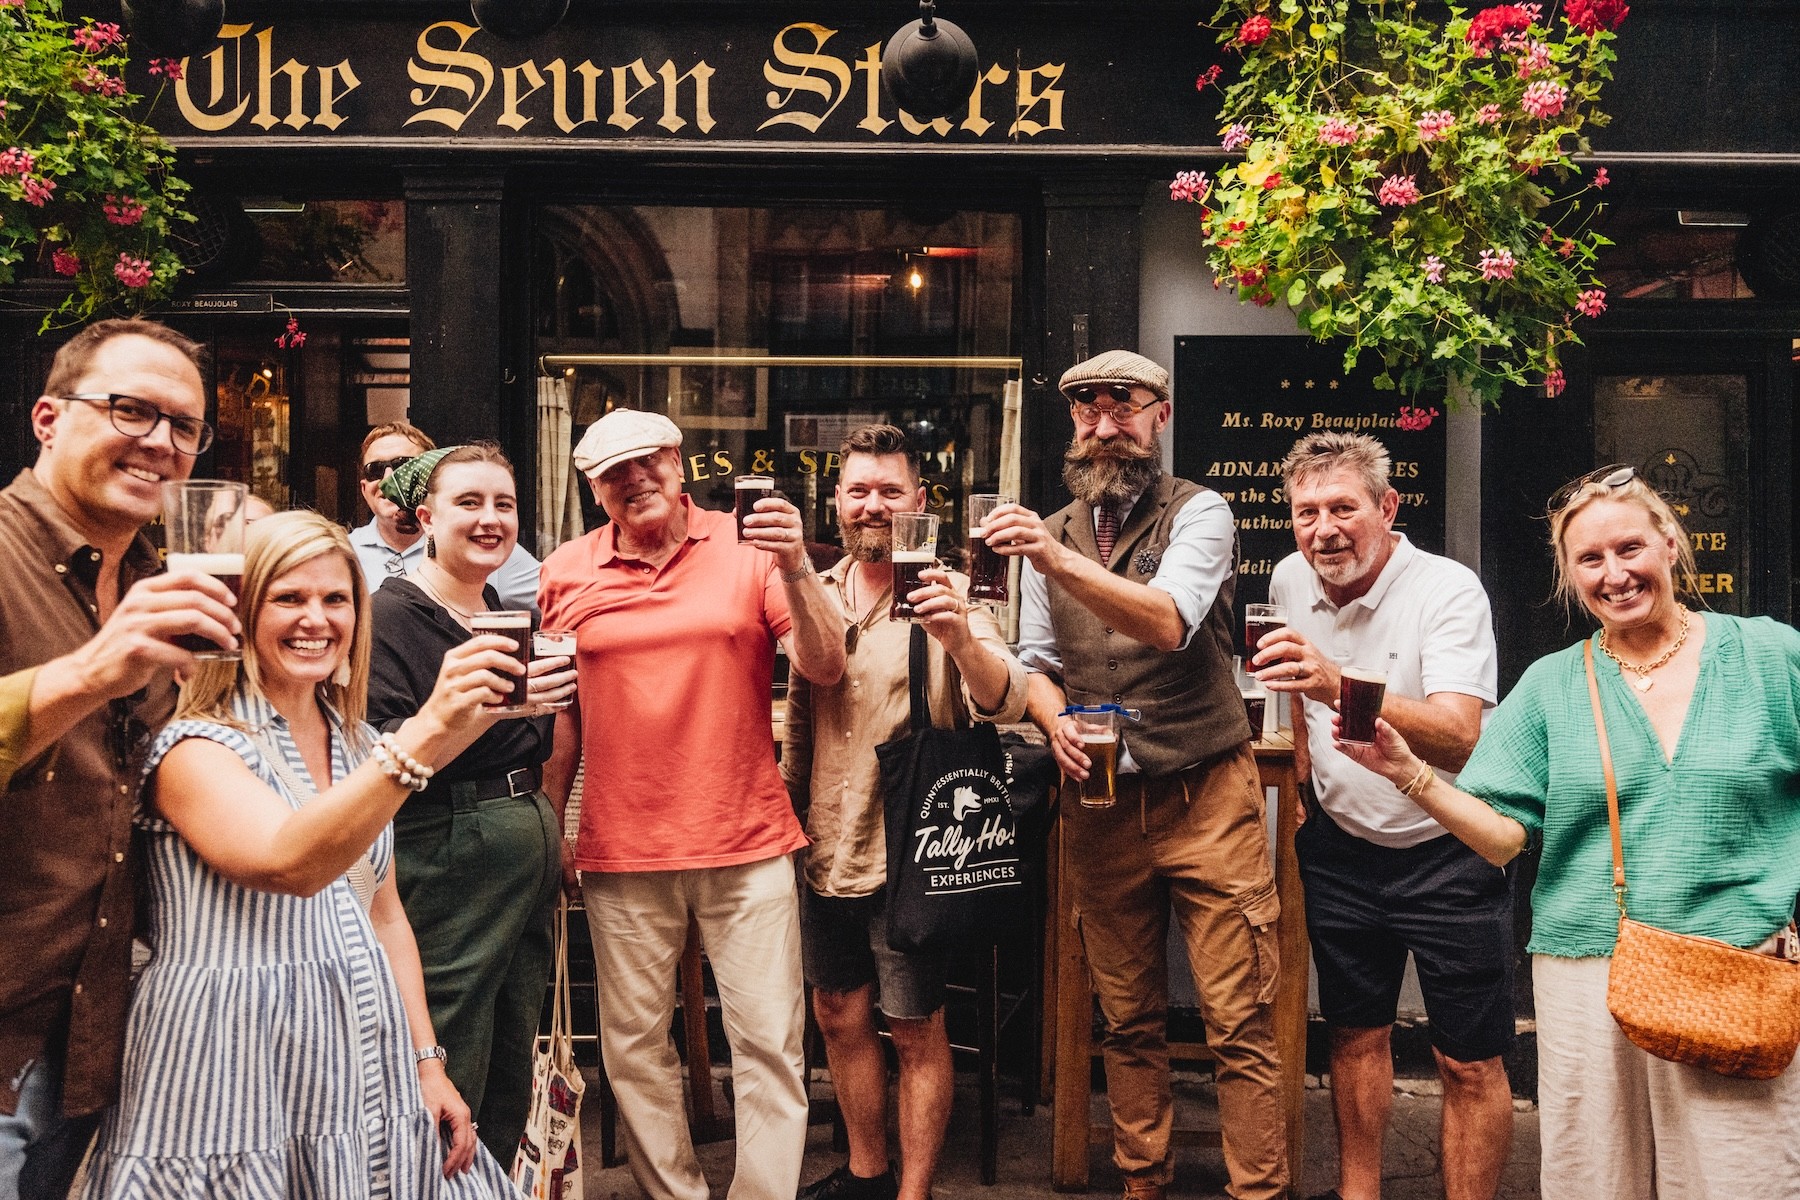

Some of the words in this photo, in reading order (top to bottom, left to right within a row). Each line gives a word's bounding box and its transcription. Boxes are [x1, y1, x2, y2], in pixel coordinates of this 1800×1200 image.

[174, 22, 362, 132] The
[402, 20, 717, 134] Seven
[756, 22, 1066, 138] Strs
[194, 300, 238, 308] BEAUJOLAIS
[1221, 412, 1253, 428] Ms.
[1260, 412, 1305, 431] Roxy
[1311, 412, 1403, 432] Beaujolai
[752, 449, 775, 474] &
[1206, 461, 1286, 478] ADNAM
[1241, 488, 1266, 503] the
[920, 768, 989, 819] QUINTESSENTIALLY
[914, 825, 975, 870] Tally
[976, 814, 1016, 853] Ho!
[930, 867, 1016, 887] EXPERIENCES
